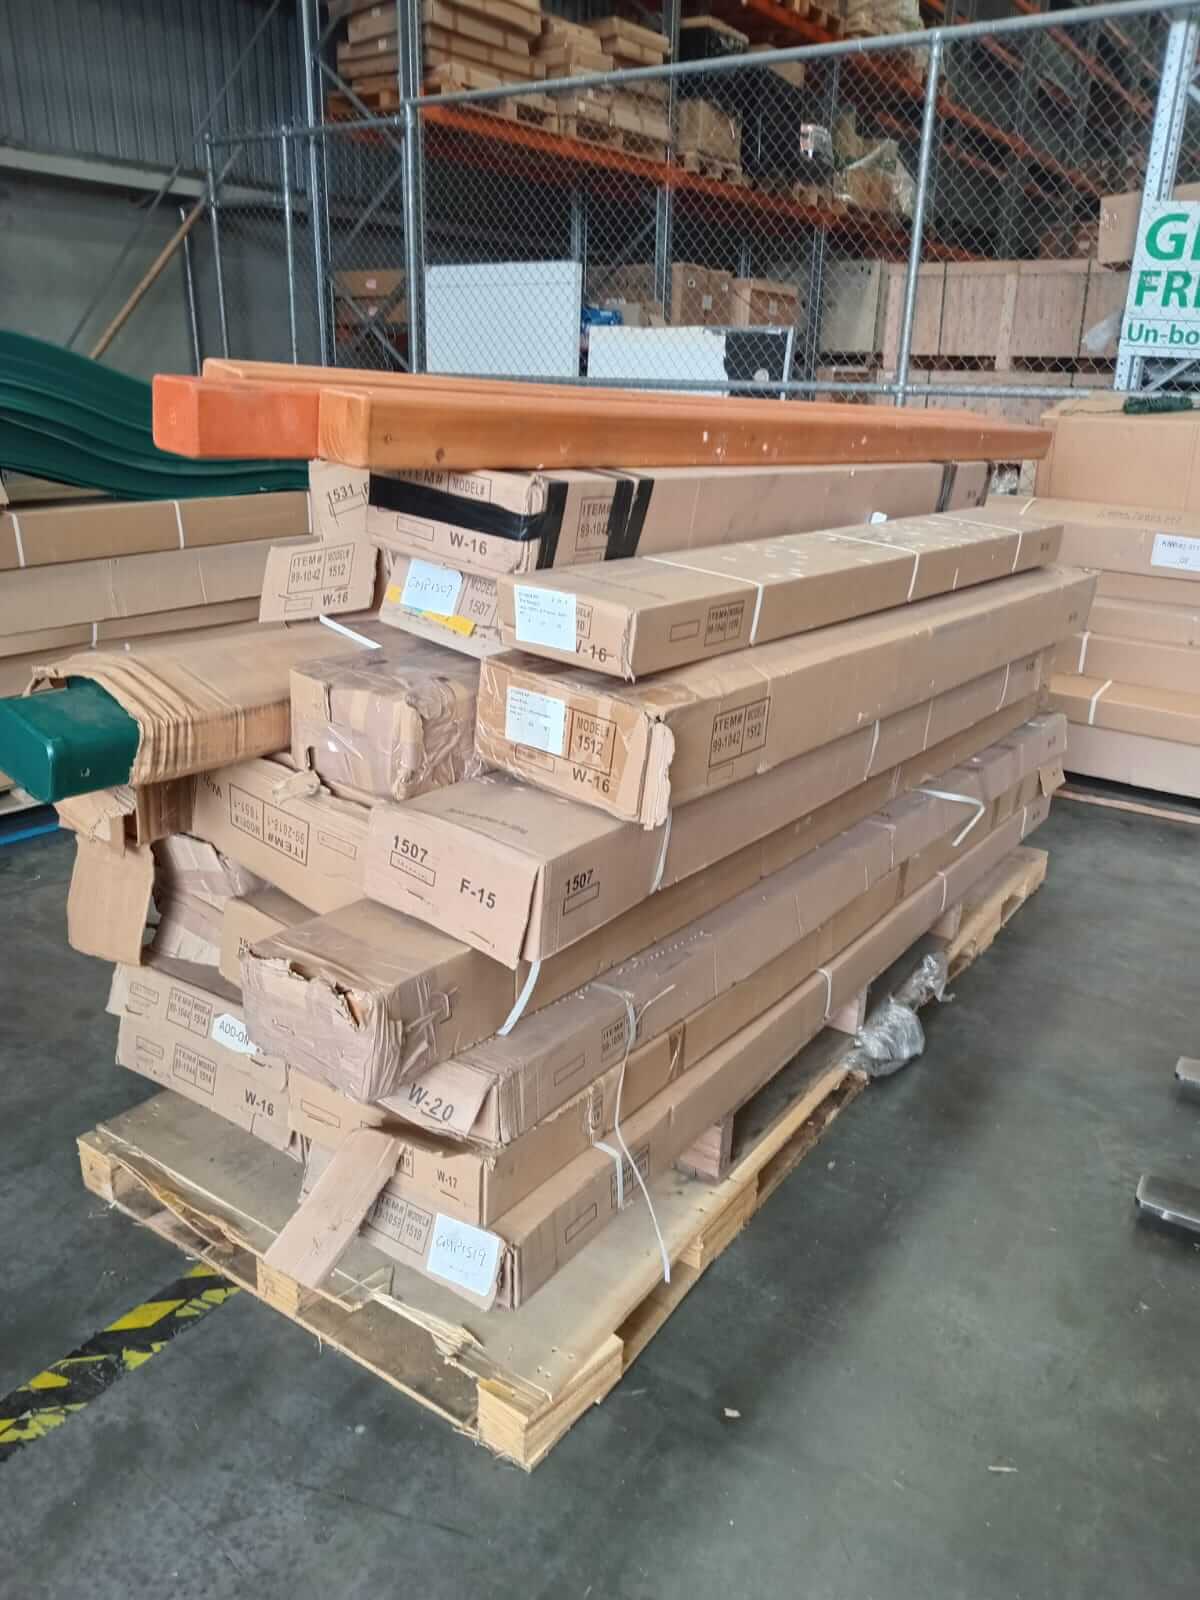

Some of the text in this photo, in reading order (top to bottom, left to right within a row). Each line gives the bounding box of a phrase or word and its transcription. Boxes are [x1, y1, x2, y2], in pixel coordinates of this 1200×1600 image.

[1145, 213, 1200, 260] G
[449, 531, 488, 556] W-16
[292, 554, 322, 569] ITEM#
[329, 564, 346, 577] 1512
[322, 592, 349, 606] W-16
[469, 600, 491, 616] 1507
[714, 712, 742, 732] ITEM#
[578, 735, 604, 757] 1512
[572, 767, 611, 793] W-16
[268, 832, 304, 859] ITEM#
[393, 835, 428, 863] 1507
[460, 878, 496, 909] F-15
[566, 868, 594, 894] 1507
[245, 1088, 273, 1116] W-16
[409, 1082, 454, 1121] W-20
[437, 1170, 458, 1189] W-17
